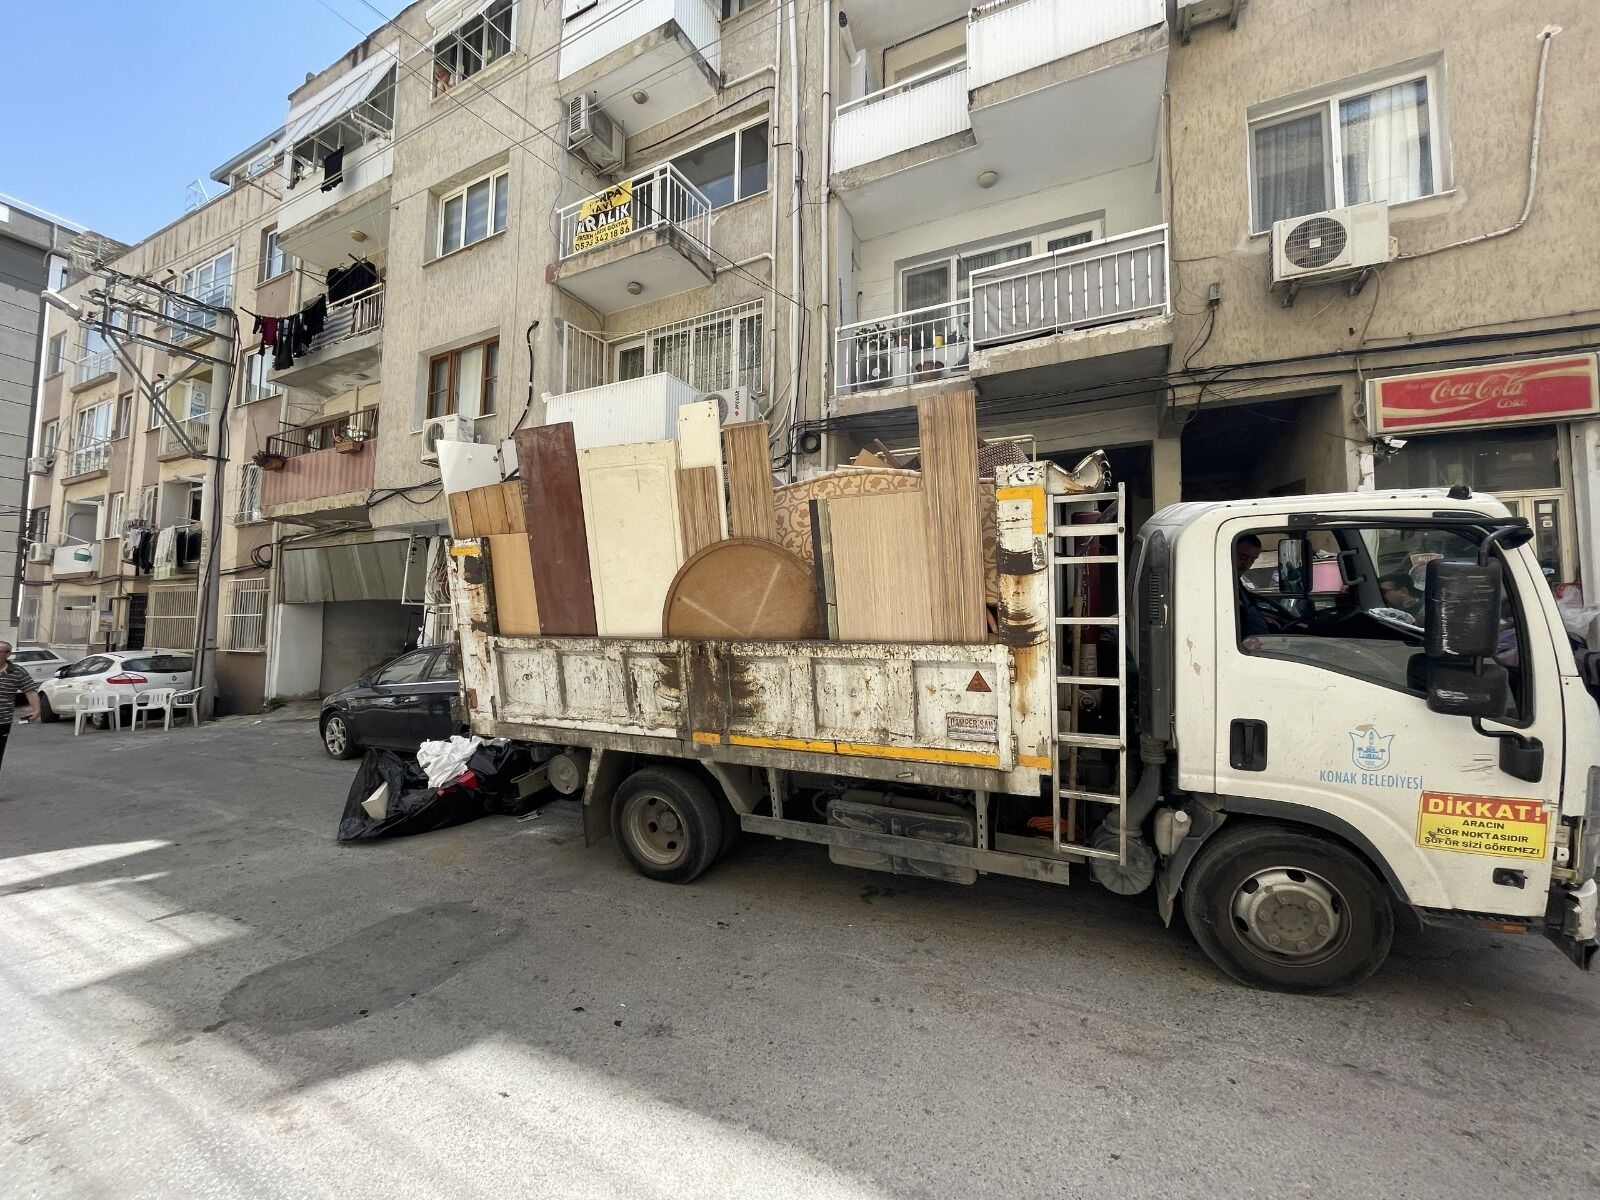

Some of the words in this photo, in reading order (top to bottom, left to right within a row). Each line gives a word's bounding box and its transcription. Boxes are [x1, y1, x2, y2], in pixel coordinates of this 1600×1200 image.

[1430, 373, 1524, 403] Coca-Cola
[1319, 769, 1358, 785] KONAK
[1361, 772, 1423, 790] BELEDİYESİ
[1428, 796, 1542, 822] DİKKAT!
[1462, 819, 1505, 830] ARACIN
[1437, 826, 1459, 836] KÖR
[1461, 830, 1529, 843] NOKTASIDIR
[1484, 842, 1541, 855] GÖREMEZ!
